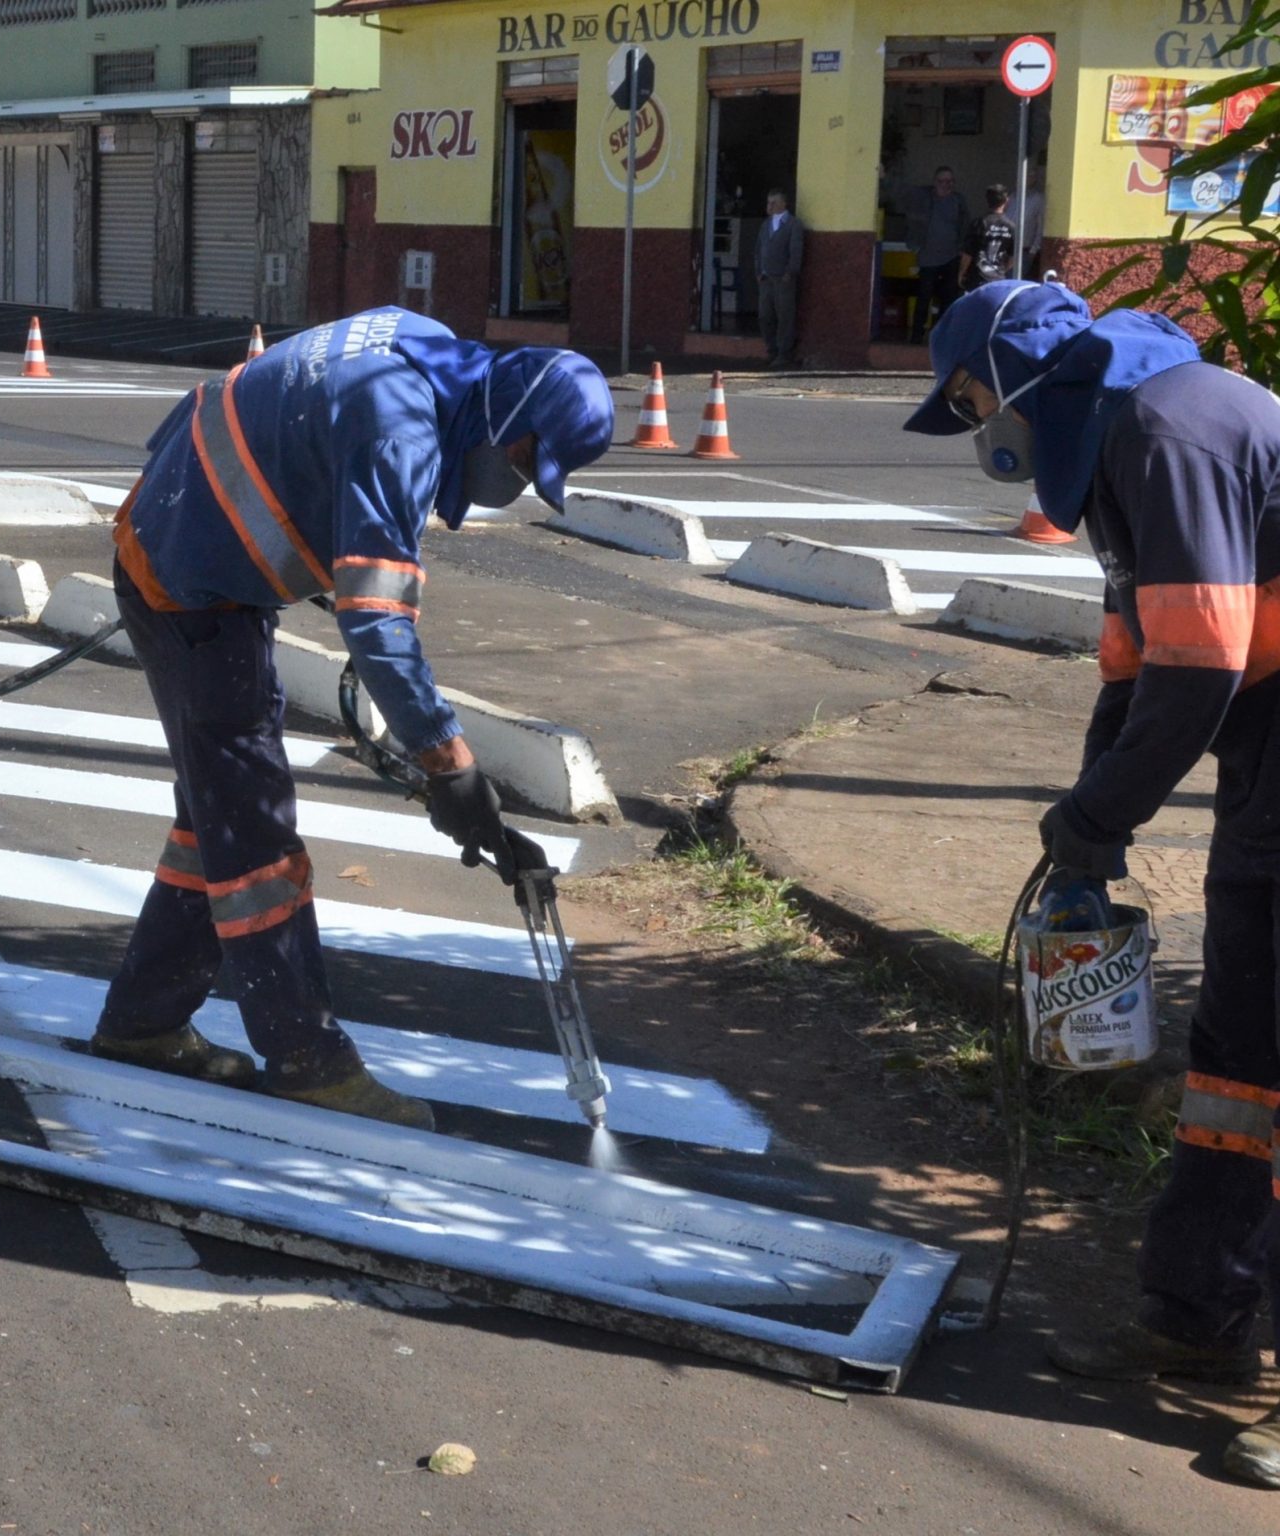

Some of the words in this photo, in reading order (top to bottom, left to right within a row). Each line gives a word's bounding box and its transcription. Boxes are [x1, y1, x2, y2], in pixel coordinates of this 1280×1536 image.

[497, 12, 566, 54] BAR
[572, 18, 598, 39] DO
[391, 109, 477, 160] SKOL
[1069, 1013, 1104, 1025] LATEX
[1070, 1024, 1111, 1034] PREMIUM
[1113, 1020, 1132, 1032] PLUS
